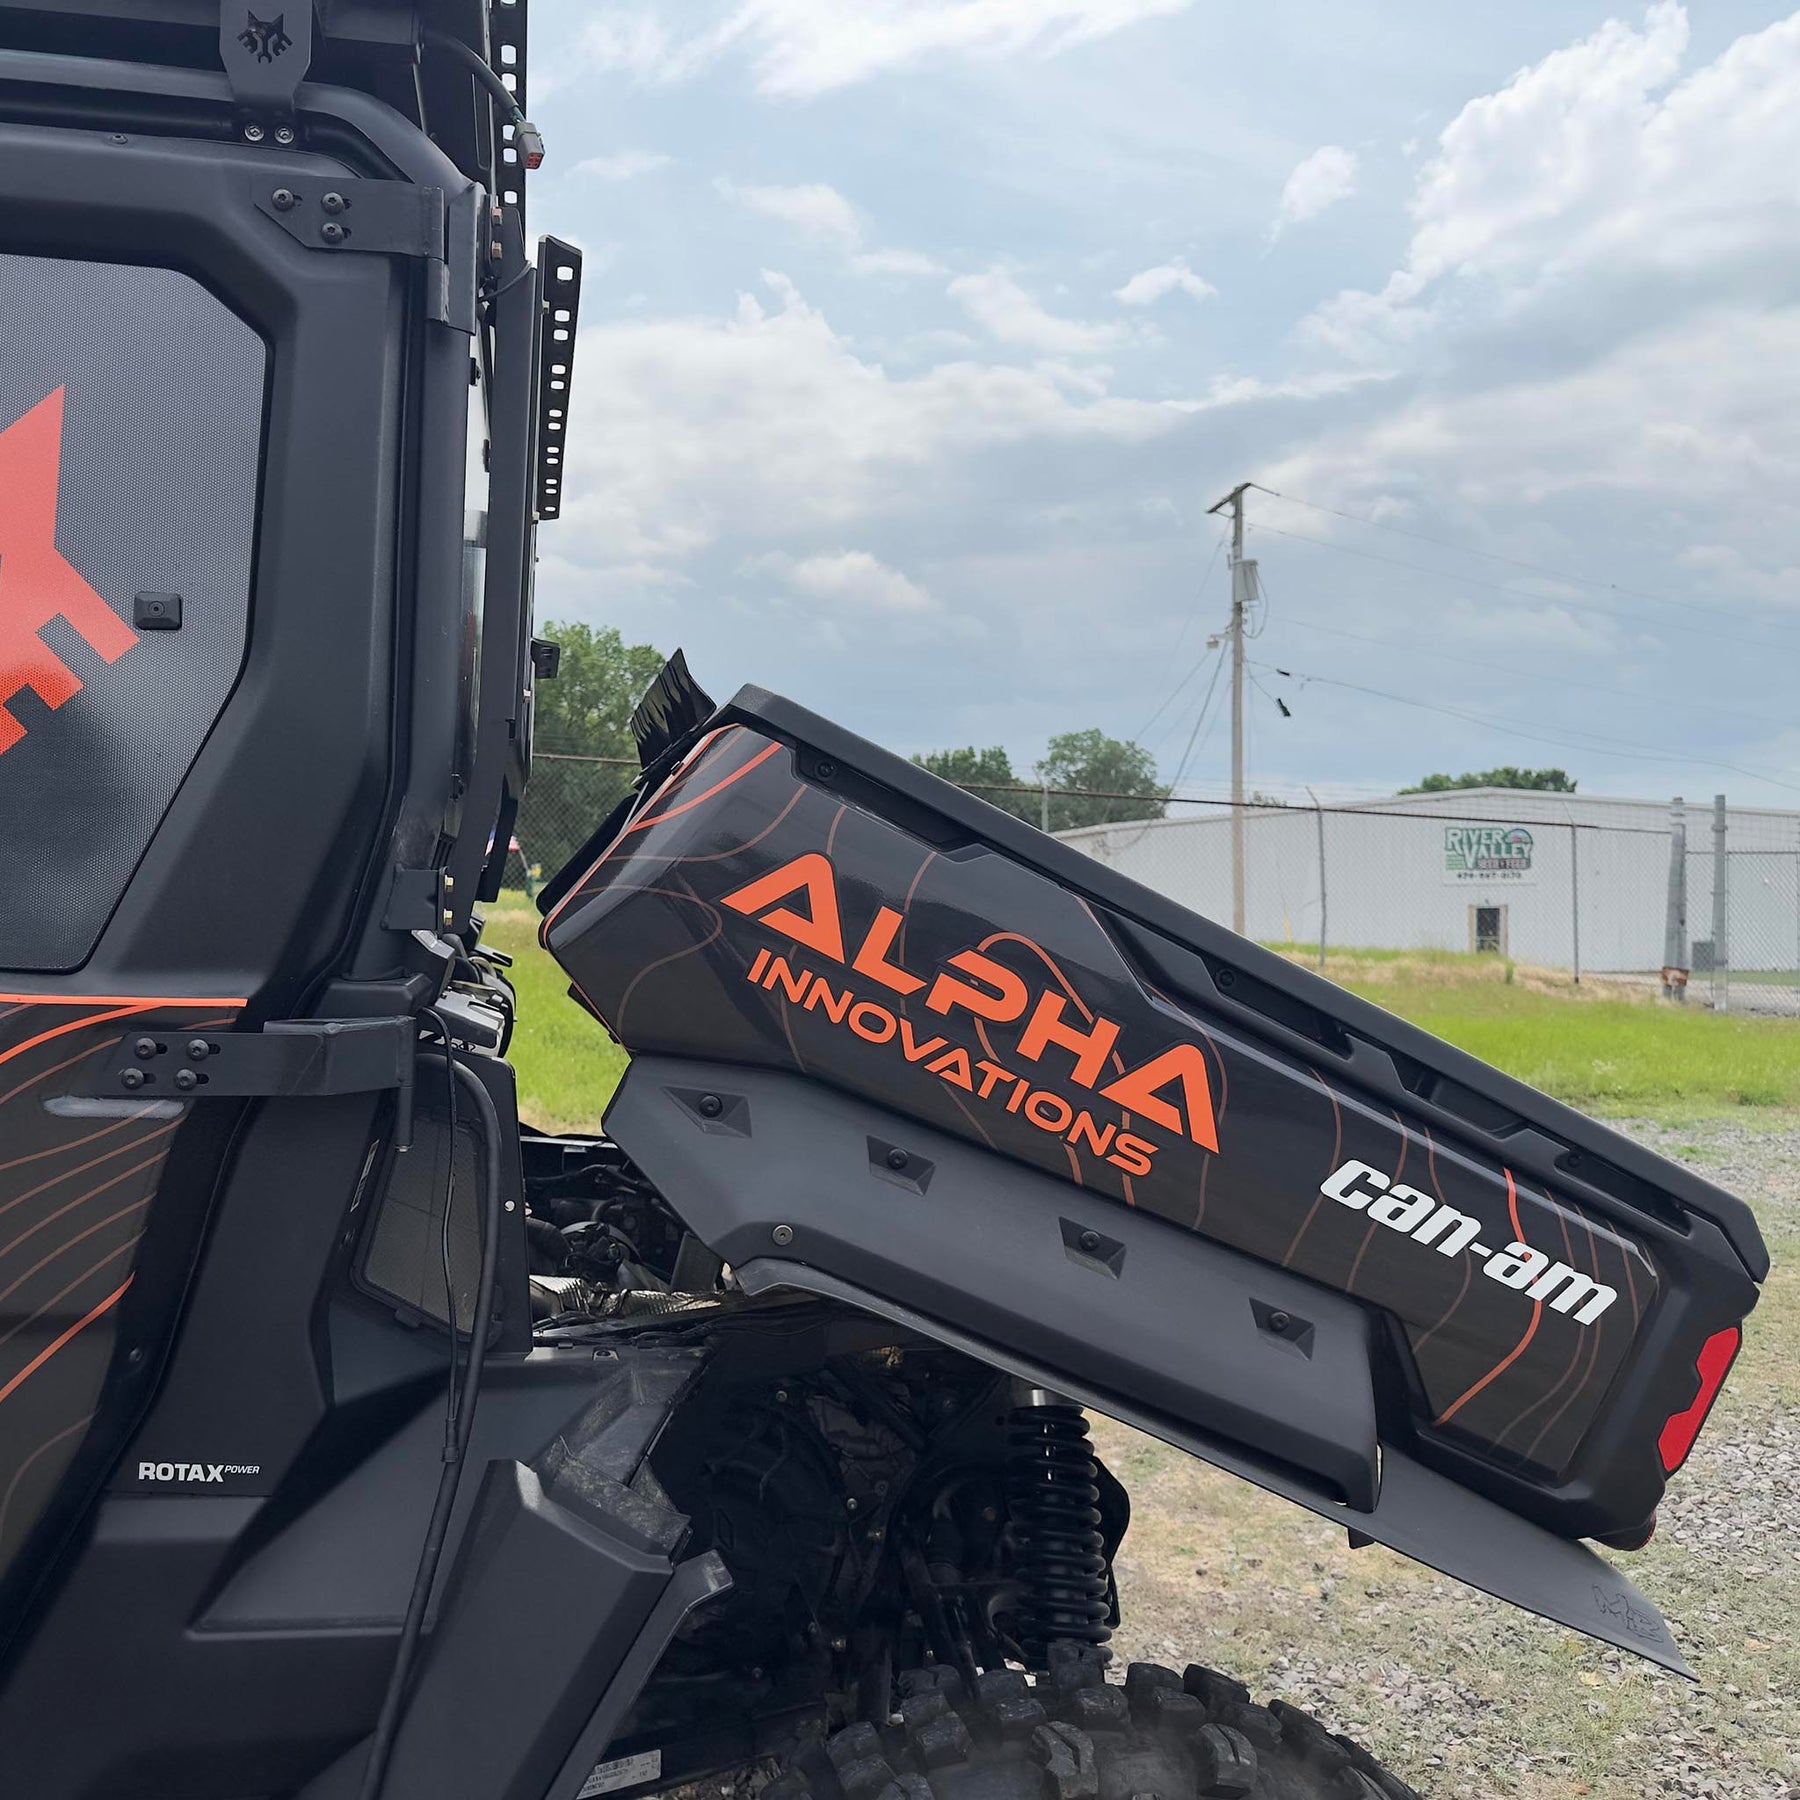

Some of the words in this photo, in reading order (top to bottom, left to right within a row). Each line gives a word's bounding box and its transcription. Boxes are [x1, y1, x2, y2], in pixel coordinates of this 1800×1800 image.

[1445, 828, 1503, 856] RIVER
[1462, 842, 1533, 869] VALLEY
[720, 852, 1219, 1155] ALPHA
[746, 948, 1159, 1177] INNOVATIONS
[138, 1462, 225, 1483] ROTAX
[224, 1465, 260, 1475] POWER
